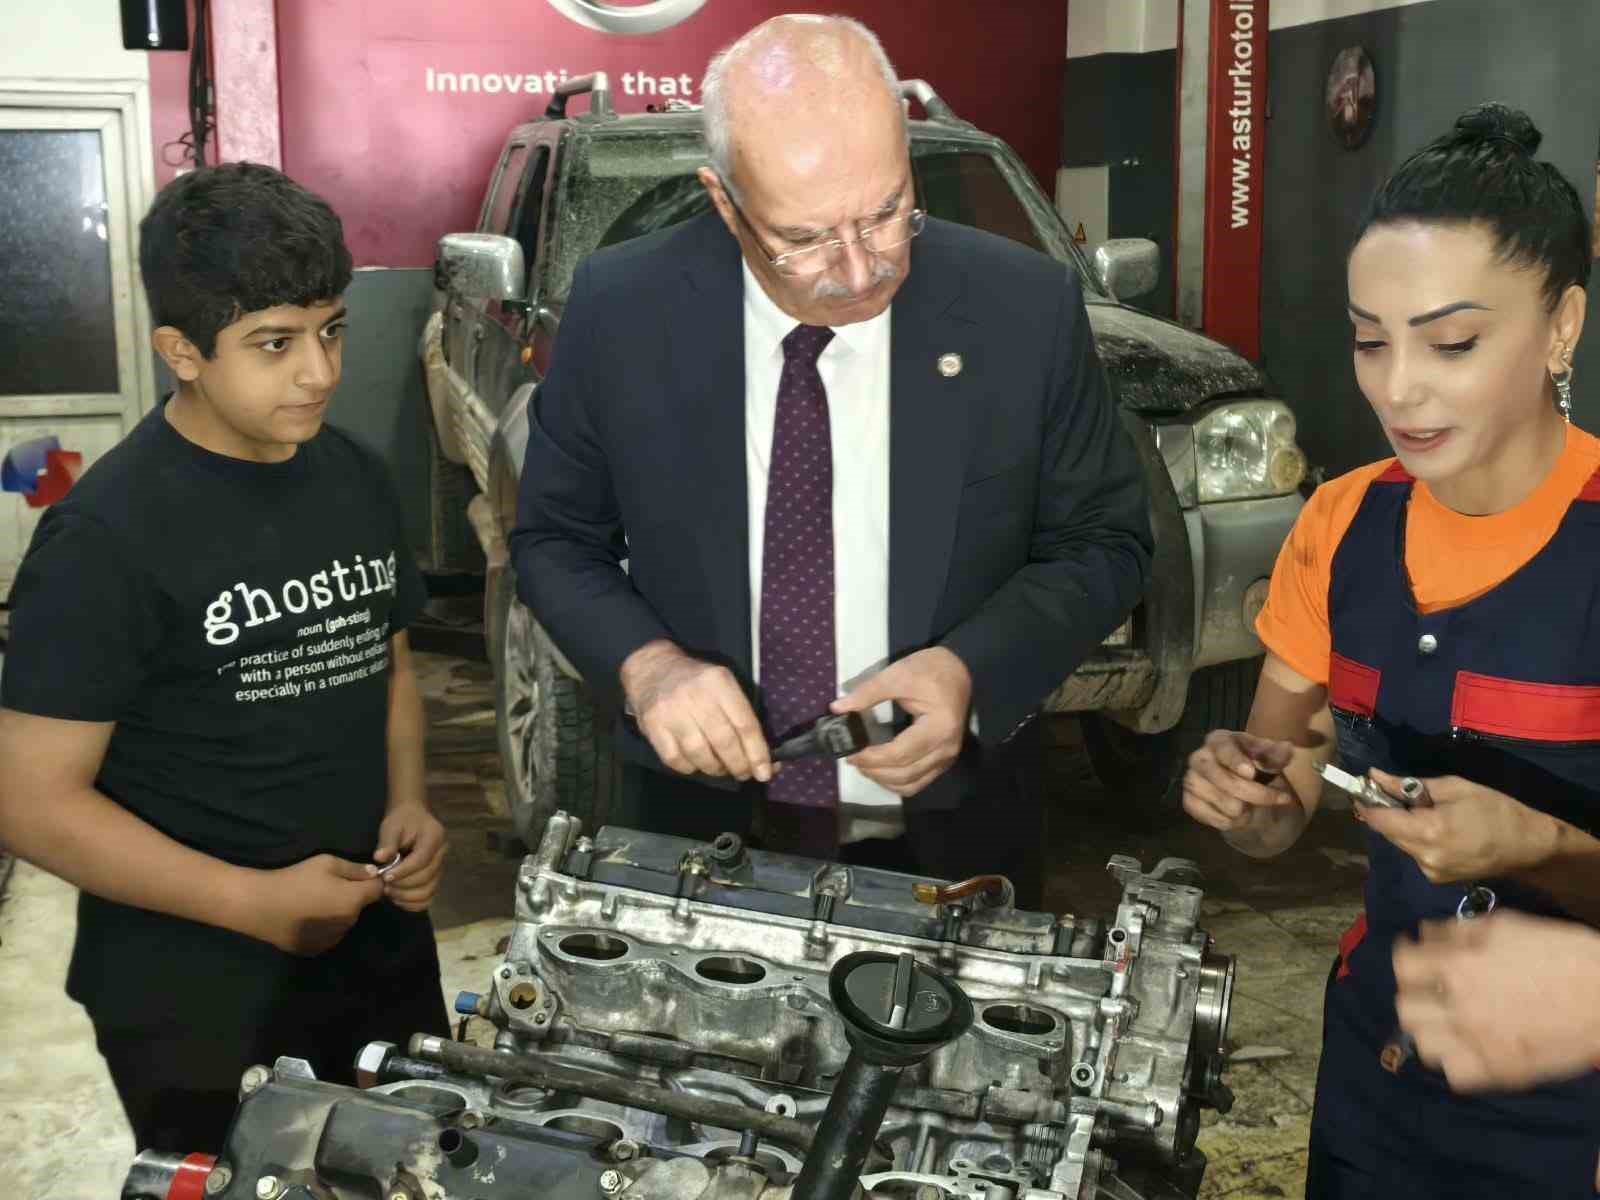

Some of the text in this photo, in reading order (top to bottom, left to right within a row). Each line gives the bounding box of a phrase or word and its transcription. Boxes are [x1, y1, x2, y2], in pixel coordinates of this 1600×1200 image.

[621, 71, 693, 96] that
[1228, 0, 1254, 229] www.asturkotol
[296, 623, 323, 638] noun
[240, 650, 289, 667] practice
[306, 635, 355, 656] suddenly
[240, 668, 272, 683] with
[284, 660, 325, 680] person
[326, 650, 364, 669] without
[235, 680, 301, 702] especially
[304, 679, 316, 692] in
[319, 678, 327, 689] a
